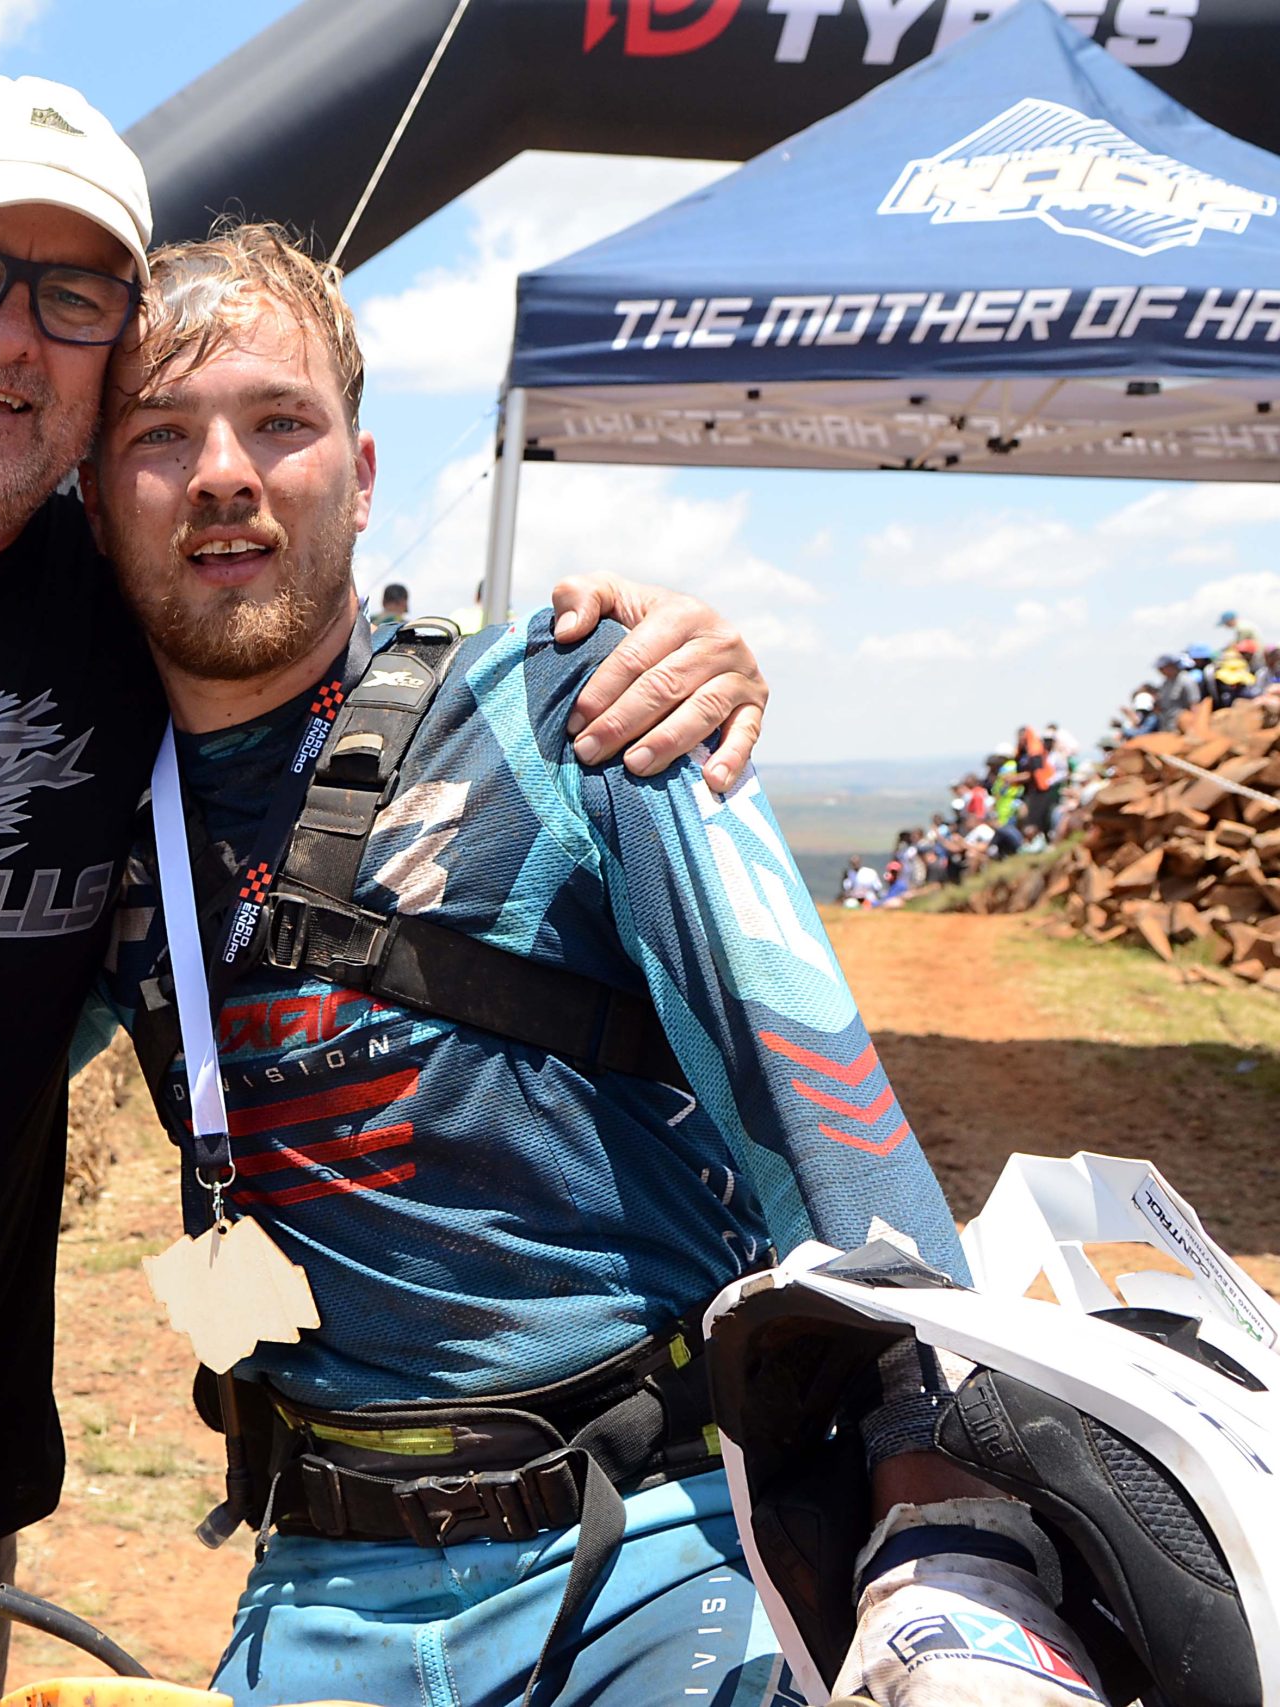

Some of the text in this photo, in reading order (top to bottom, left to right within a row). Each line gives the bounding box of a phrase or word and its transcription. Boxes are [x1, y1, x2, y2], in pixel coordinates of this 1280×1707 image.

[612, 298, 753, 350] THE
[751, 288, 1072, 347] MOTHER
[1070, 286, 1187, 340] OF
[293, 717, 322, 774] ENDURO
[308, 721, 331, 758] HARD
[225, 902, 253, 963] ENDURO
[239, 904, 261, 947] HARD
[218, 988, 397, 1057] RAC
[1145, 1190, 1211, 1279] CONTROL
